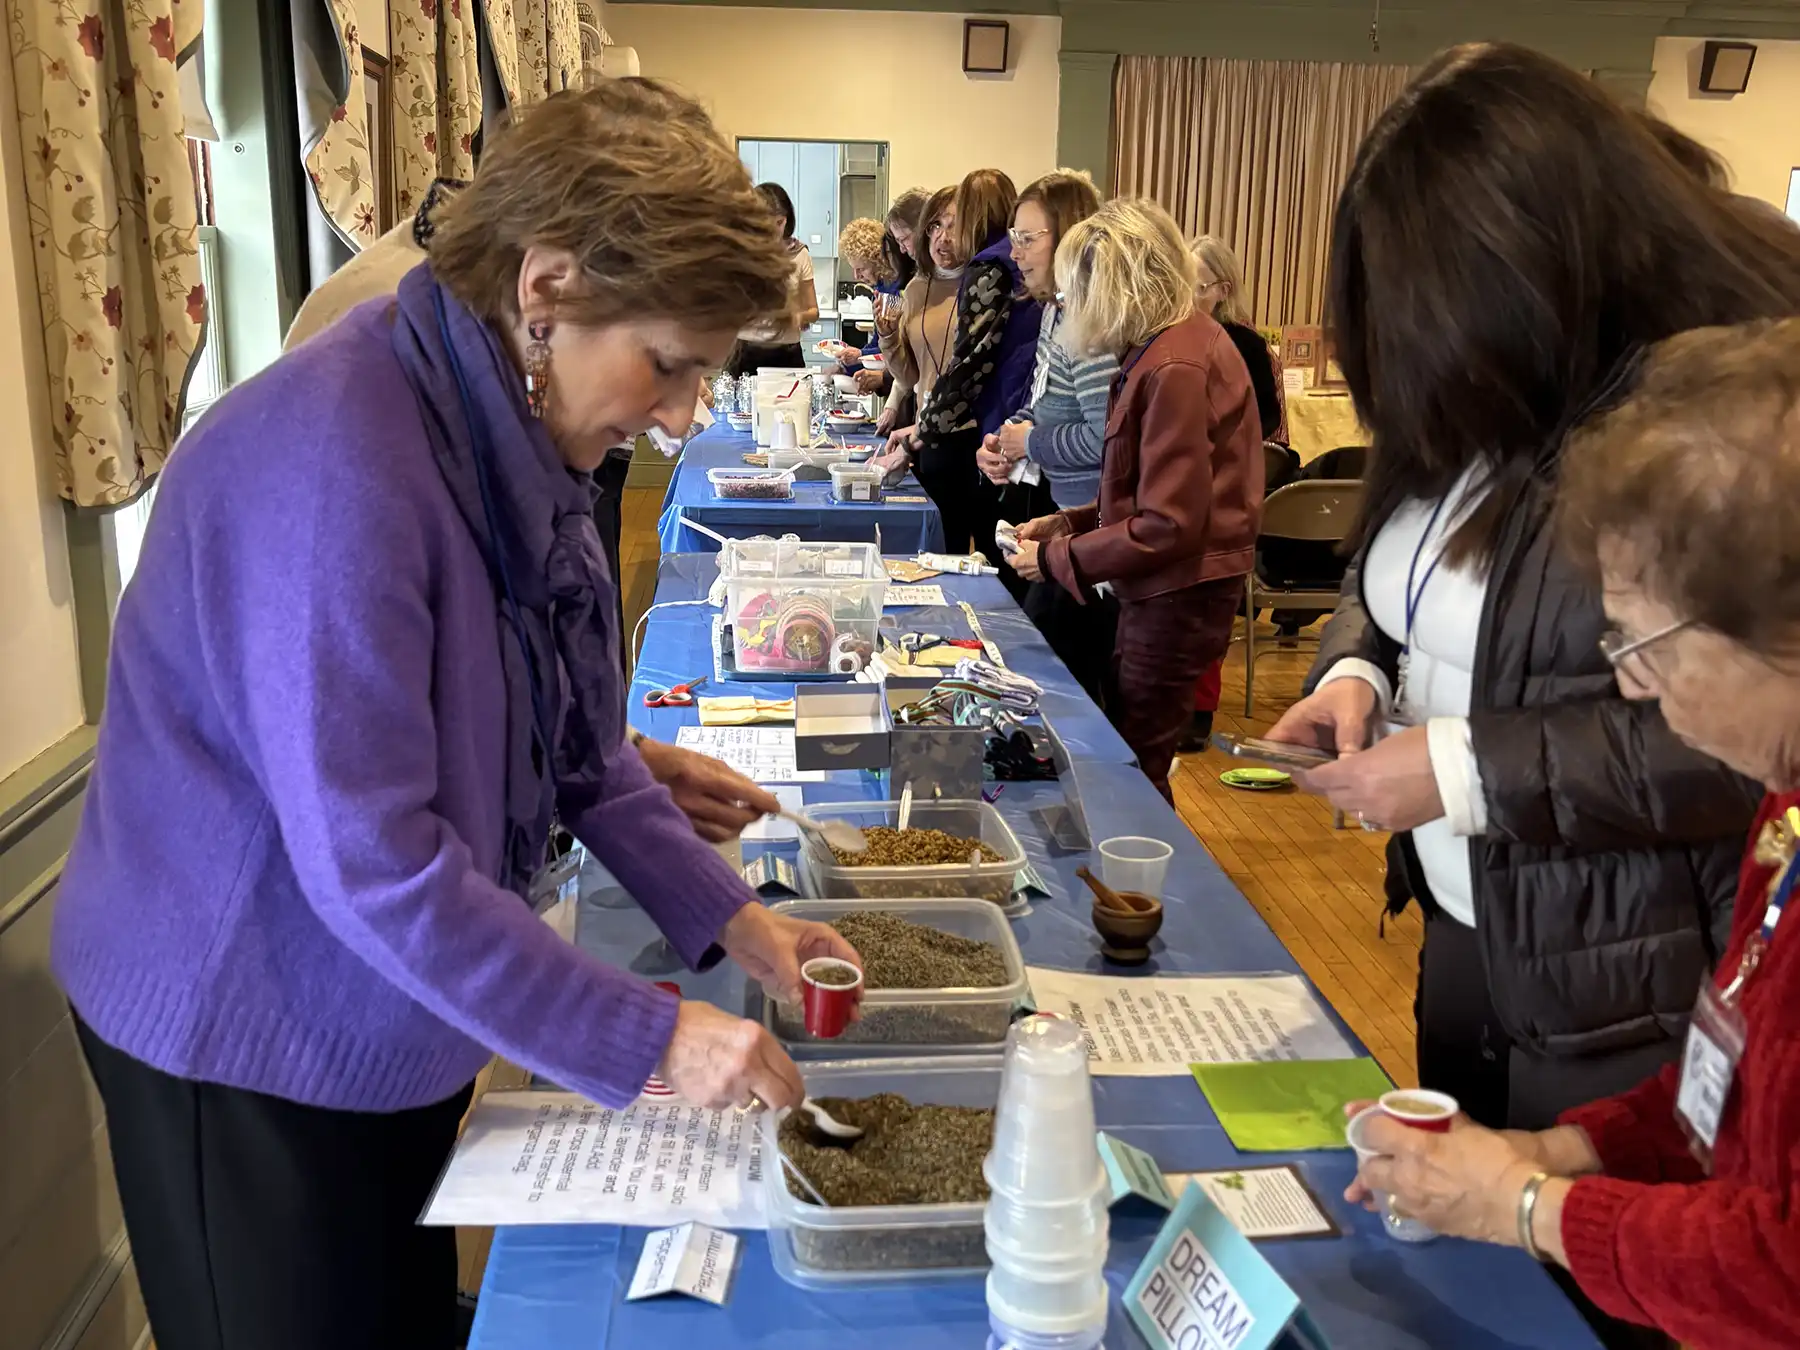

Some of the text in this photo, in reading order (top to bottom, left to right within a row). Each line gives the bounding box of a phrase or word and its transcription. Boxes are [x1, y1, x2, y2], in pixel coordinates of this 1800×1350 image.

[592, 1109, 614, 1150] eppermint.
[683, 1134, 700, 1151] Use
[556, 1152, 578, 1191] essential
[609, 1136, 631, 1173] lavender
[624, 1184, 638, 1201] can
[1142, 1271, 1212, 1350] PILLO
[1170, 1236, 1248, 1347] DREAM
